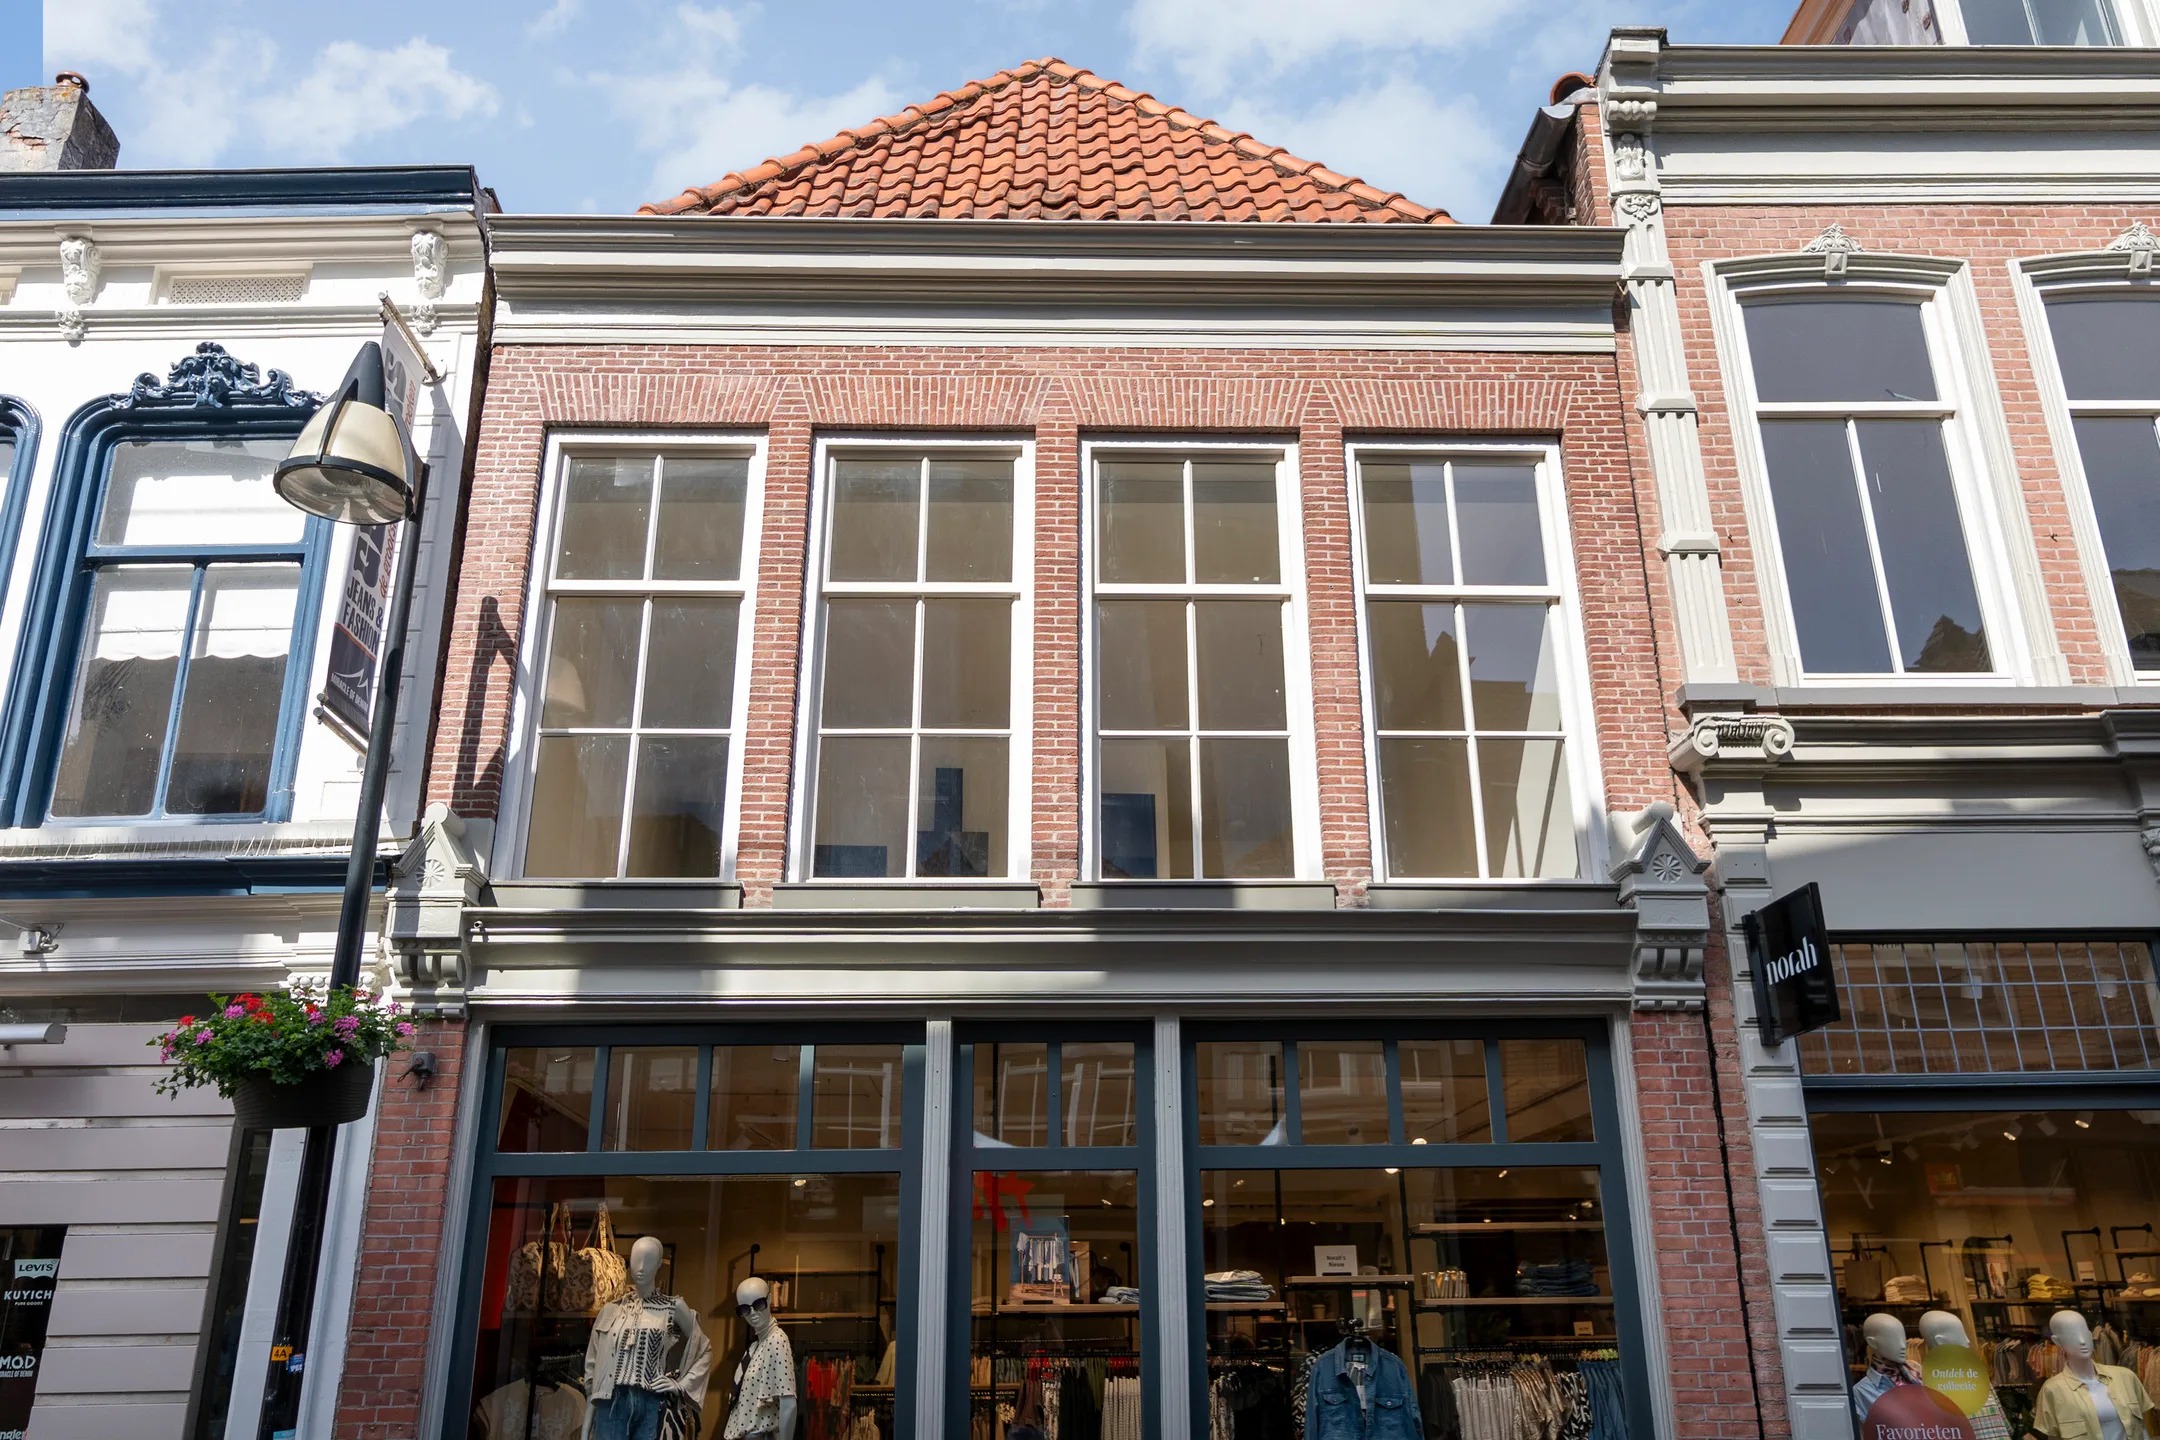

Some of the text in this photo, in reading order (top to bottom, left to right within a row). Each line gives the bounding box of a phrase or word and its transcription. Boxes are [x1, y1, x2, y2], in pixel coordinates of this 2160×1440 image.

[379, 575, 387, 599] de
[347, 576, 376, 621] JEANS
[375, 606, 384, 630] &
[343, 601, 380, 656] FASHION
[1766, 936, 1818, 986] norah
[4, 1290, 53, 1300] KUYICH
[273, 1349, 287, 1358] 4A
[1931, 1368, 1979, 1379] Ontdek de
[1876, 1423, 1963, 1440] Favorieten
